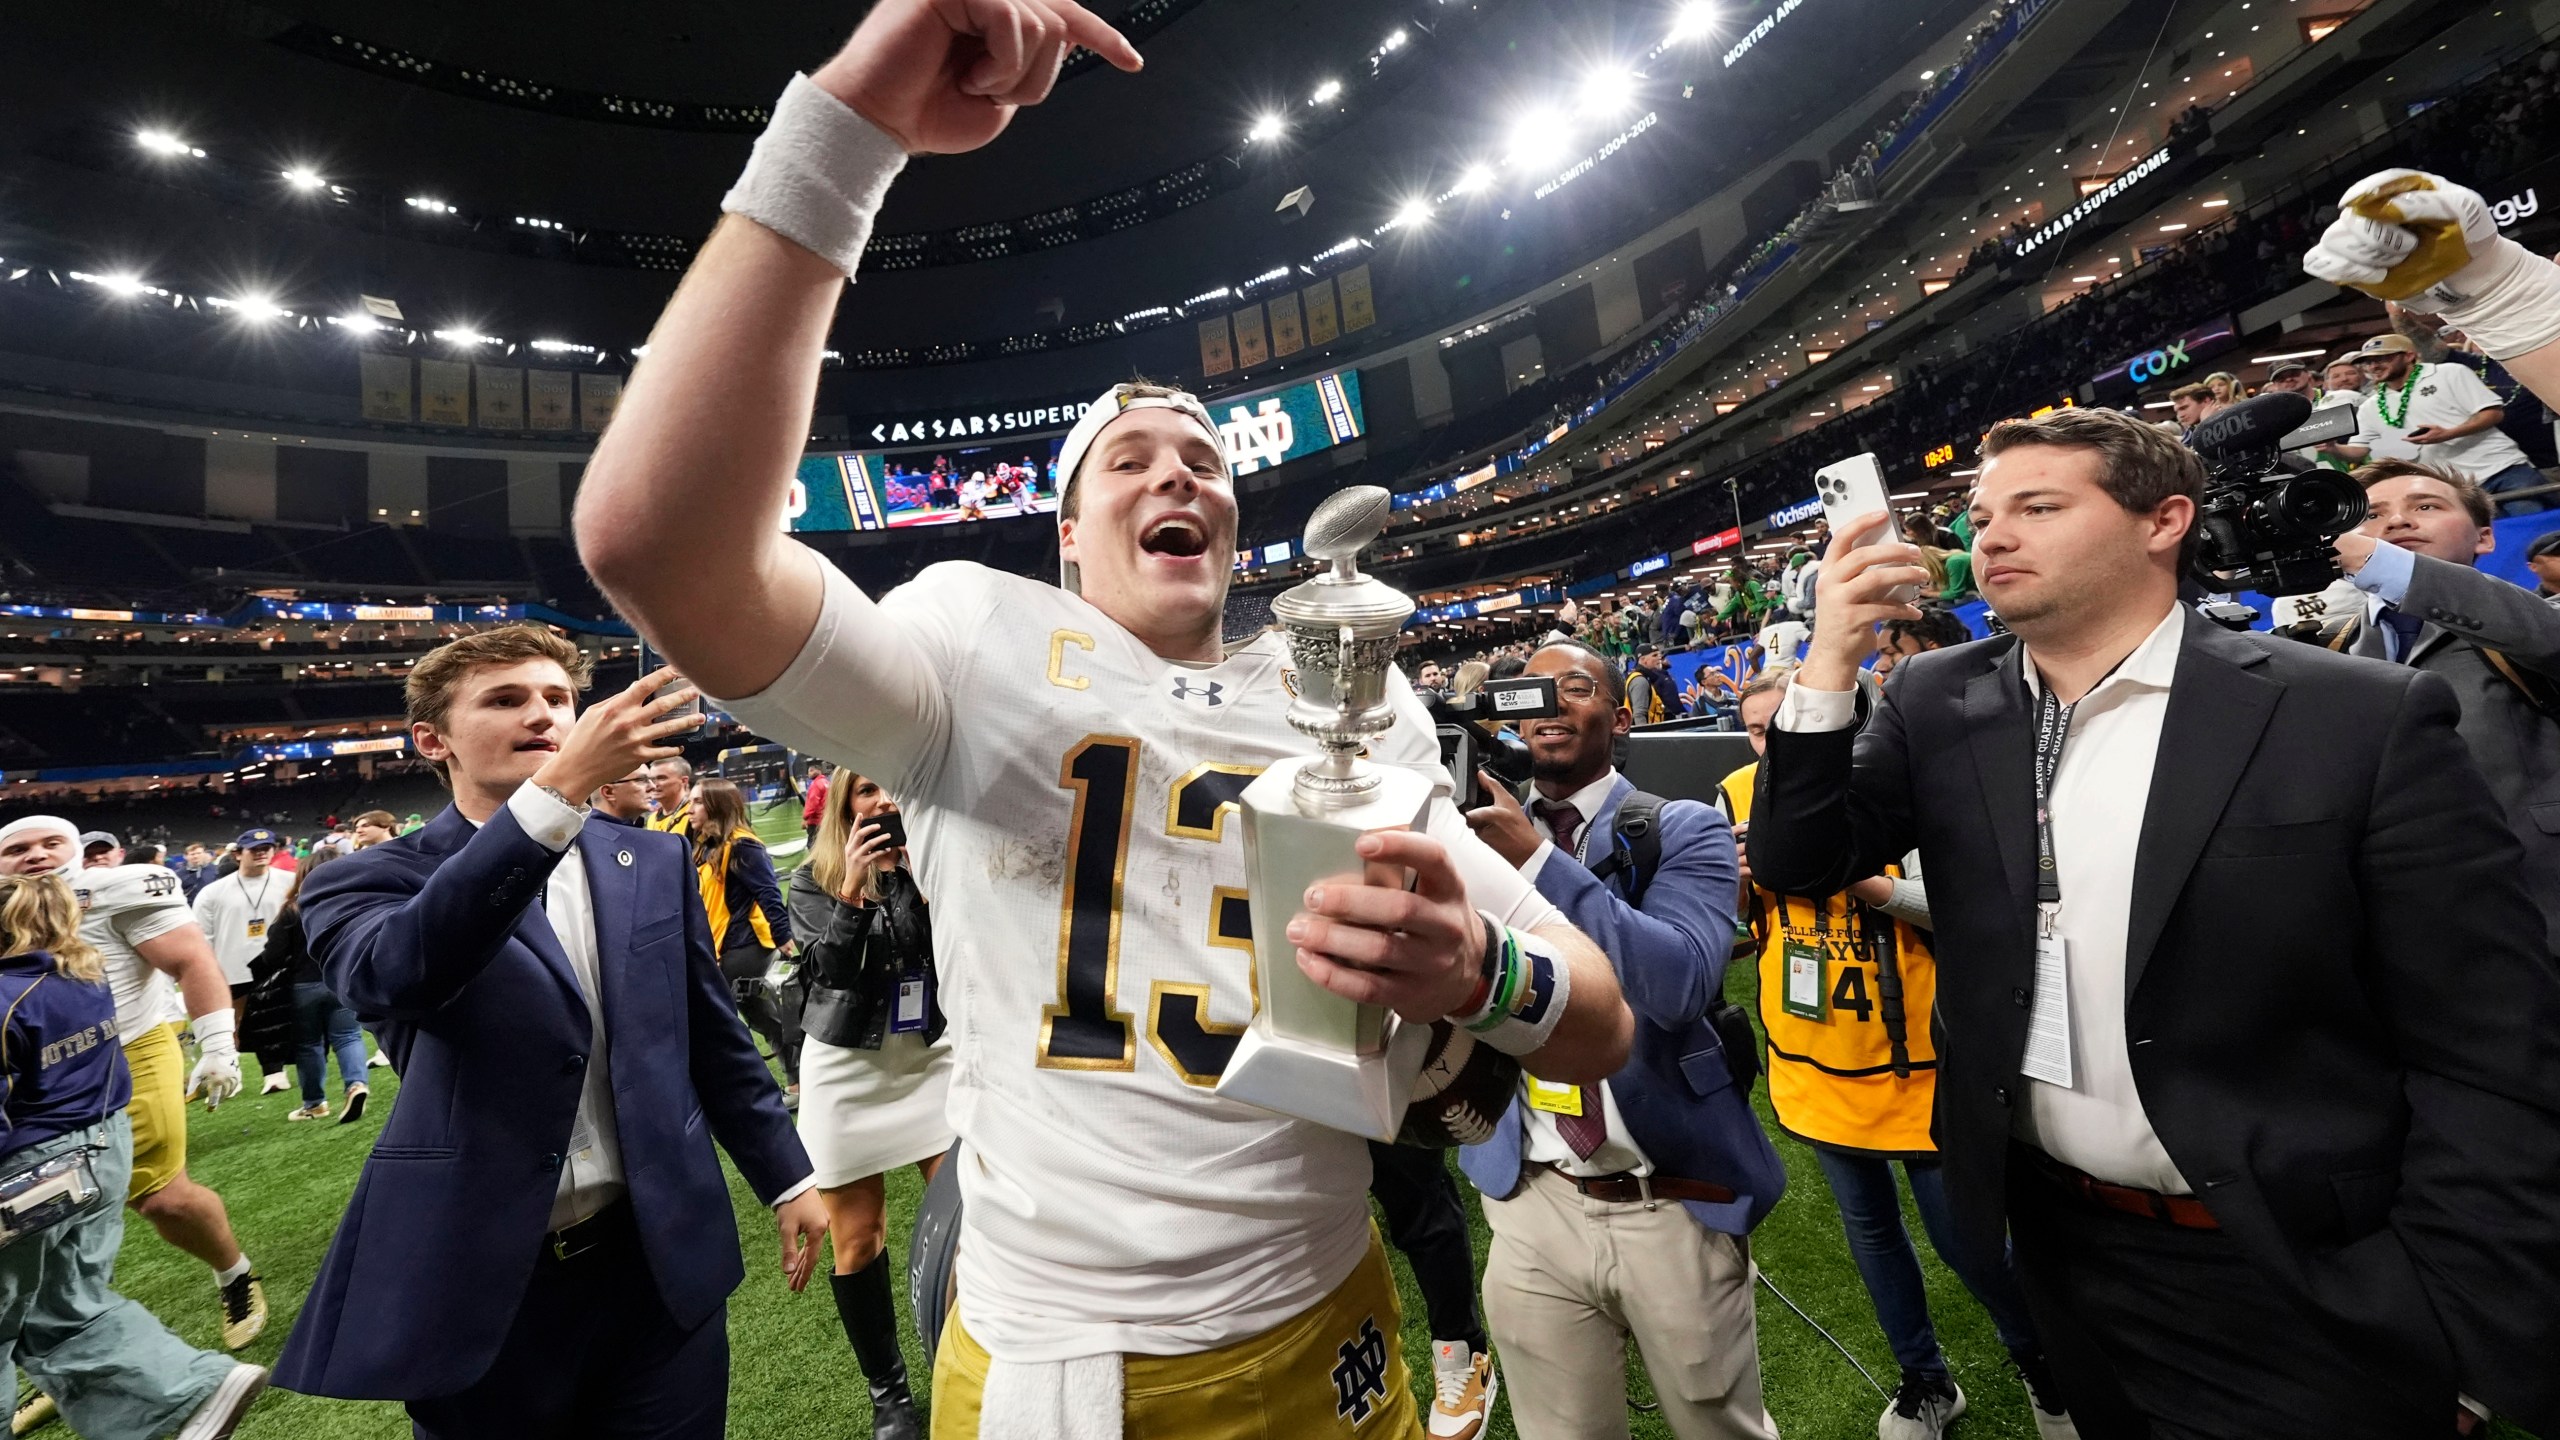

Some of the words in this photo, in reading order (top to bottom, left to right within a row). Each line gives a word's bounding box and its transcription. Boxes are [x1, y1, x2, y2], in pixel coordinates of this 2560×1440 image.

[1723, 14, 1775, 68] MORTEN
[1534, 181, 1560, 200] WILL
[1559, 156, 1594, 186] SMITH
[1598, 111, 1657, 161] 2004-2013
[2082, 147, 2171, 215] SUPERDOME
[2129, 339, 2190, 383] COX
[871, 413, 1001, 443] CAESARS
[2202, 410, 2257, 449] RØDE
[1924, 445, 1953, 468] 18:28
[1776, 499, 1824, 529] Ochsner
[1046, 628, 1095, 690] C
[1769, 632, 1779, 655] 4
[1505, 691, 1517, 701] 57
[2035, 754, 2045, 799] PLAYOFF
[2046, 756, 2056, 781] OFF
[1036, 733, 1263, 1088] 13
[1832, 966, 1883, 1022] 4
